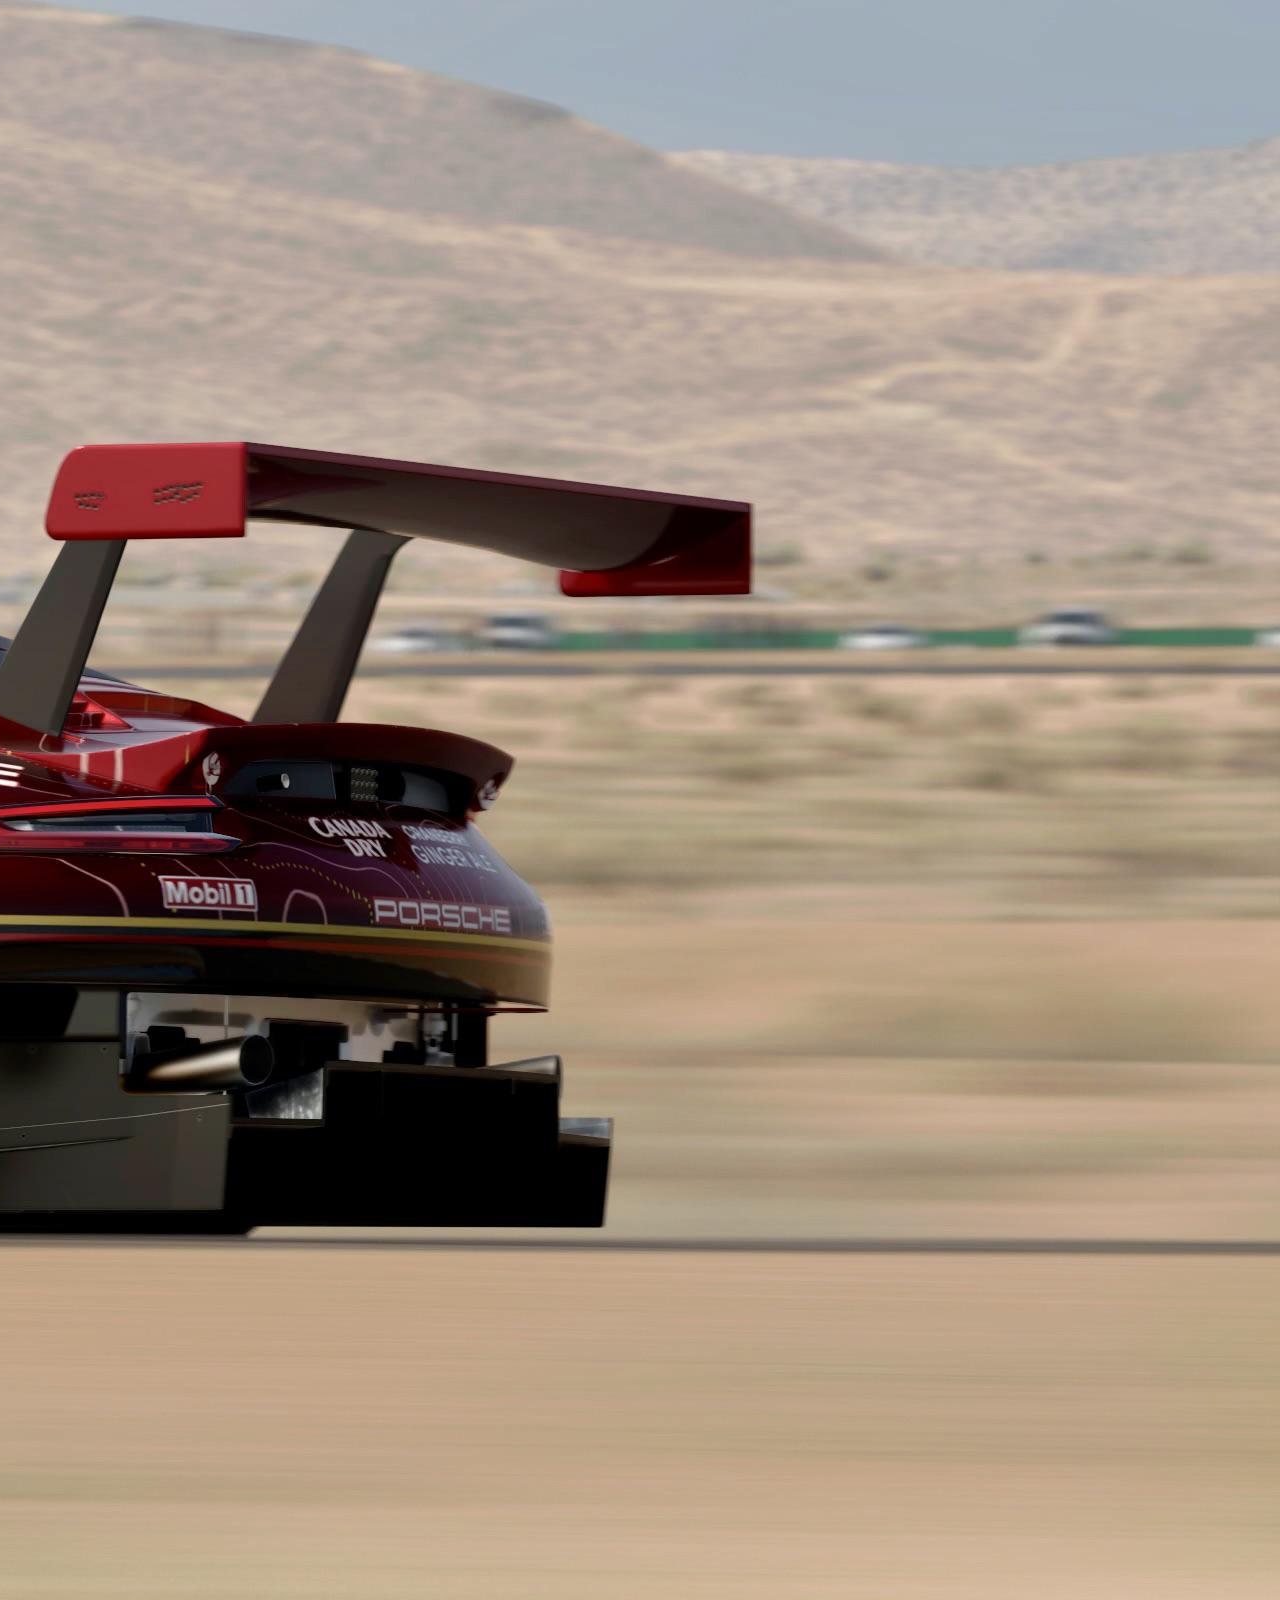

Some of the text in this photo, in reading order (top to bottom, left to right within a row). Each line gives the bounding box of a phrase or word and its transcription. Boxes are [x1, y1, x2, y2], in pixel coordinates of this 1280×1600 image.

[307, 816, 393, 839] CANADA
[343, 838, 388, 858] DRY
[164, 880, 256, 906] Mobil 1
[373, 898, 512, 933] PORSCHE
